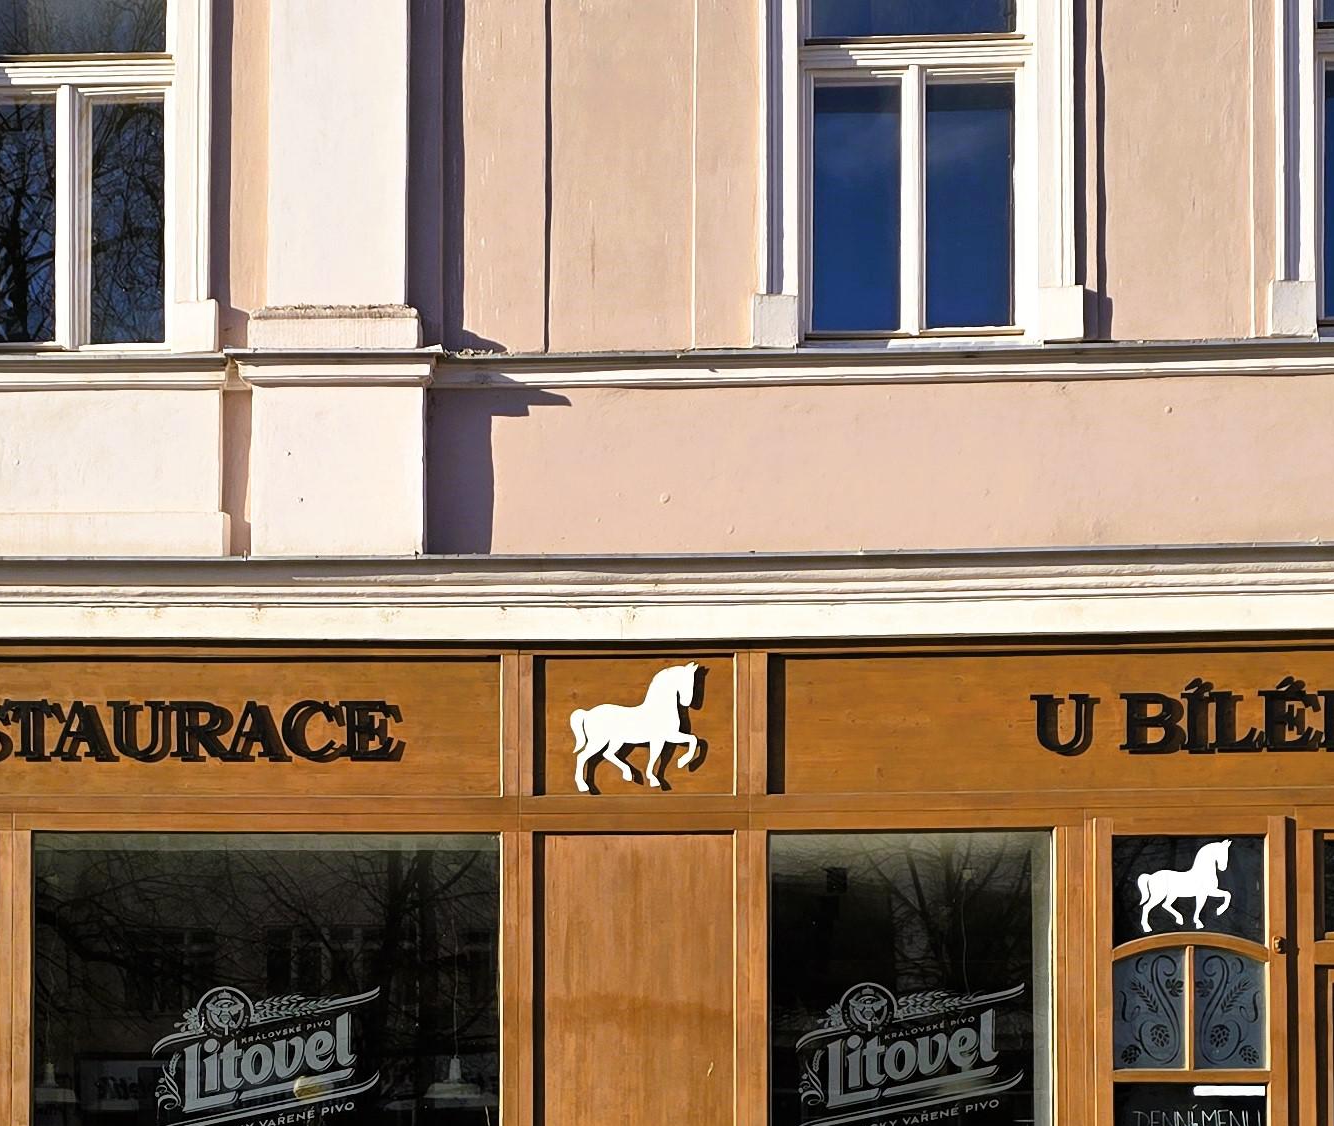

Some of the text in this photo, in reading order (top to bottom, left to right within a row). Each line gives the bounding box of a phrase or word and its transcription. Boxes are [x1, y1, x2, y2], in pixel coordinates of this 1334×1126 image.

[1030, 694, 1101, 756] U
[241, 1023, 303, 1044] KRÁLOVSKÉ
[306, 1019, 332, 1030] PIVO
[950, 1015, 976, 1026] PIVO
[182, 1011, 358, 1113] Litovel
[826, 1008, 1000, 1110] Litovel
[321, 1101, 355, 1117] PIVO
[902, 1104, 960, 1125] VAŘENÉ
[965, 1099, 1000, 1114] PIVO
